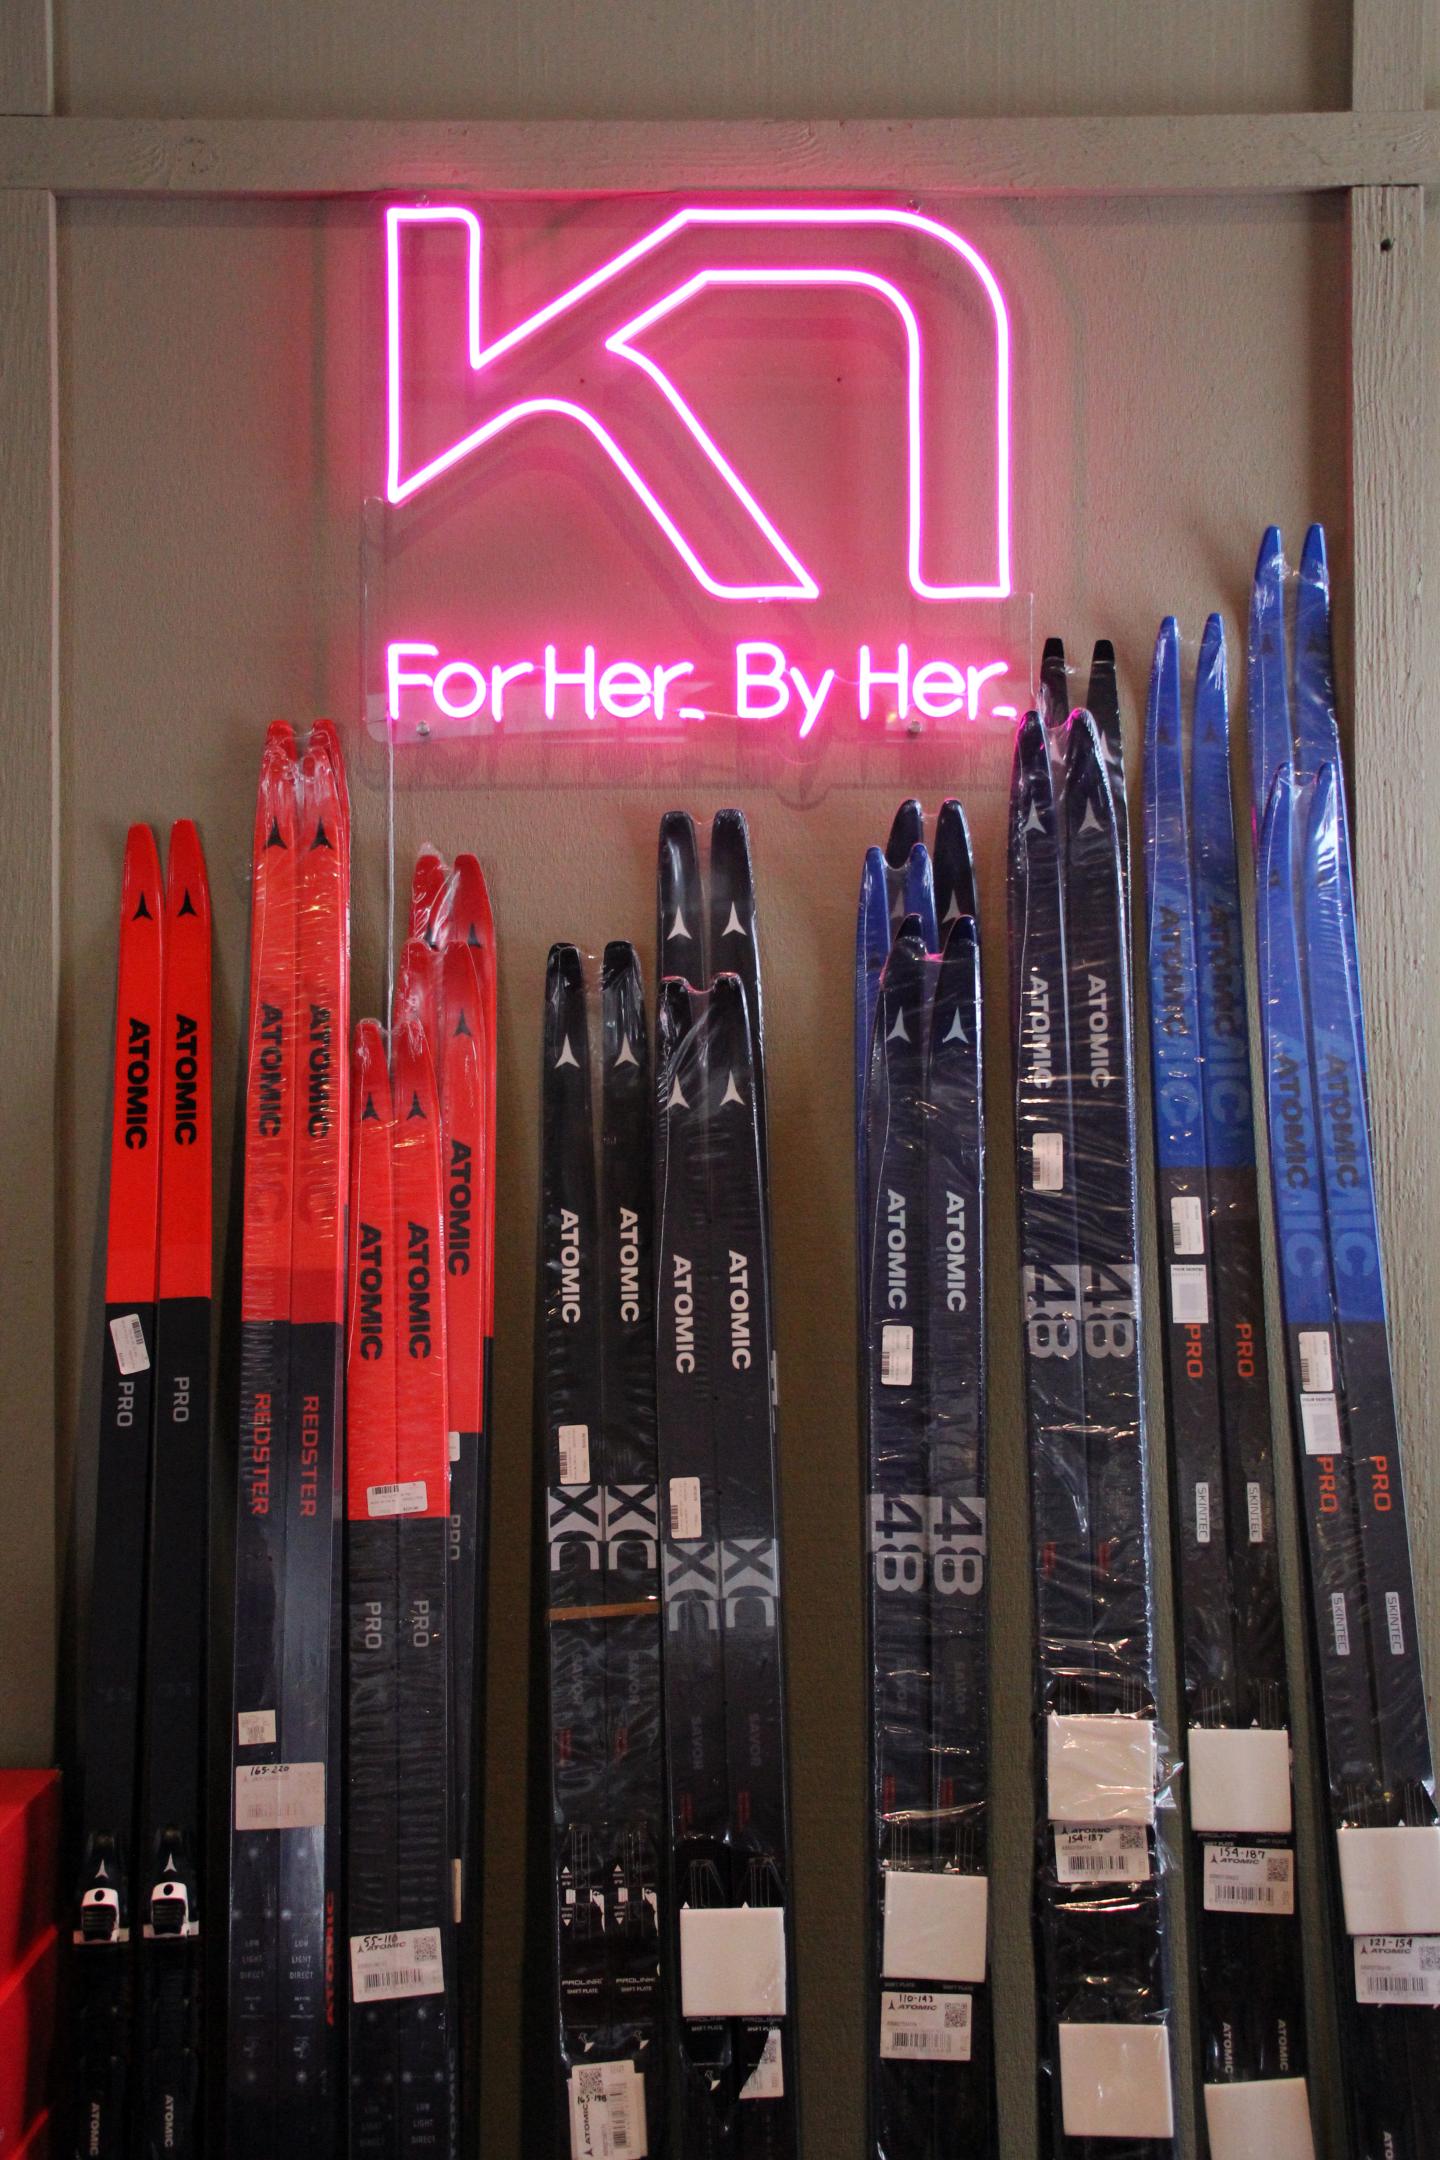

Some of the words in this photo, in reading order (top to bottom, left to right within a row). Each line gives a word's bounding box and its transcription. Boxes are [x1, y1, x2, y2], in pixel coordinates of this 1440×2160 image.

[387, 642, 535, 721] For
[736, 642, 836, 738] By
[259, 1003, 285, 1137] ATOMIC
[308, 1003, 332, 1139] ATOMIC
[1029, 974, 1052, 1090] ATOMIC
[1088, 973, 1110, 1089] ATOMIC
[125, 1018, 151, 1150] ATOMIC
[175, 1013, 198, 1146] ATOMIC
[1276, 1053, 1310, 1191] ATOMIC
[1325, 1052, 1360, 1190] ATOMIC
[448, 1139, 473, 1276] ATOMIC
[887, 1188, 907, 1311] ATOMIC
[945, 1190, 967, 1313] ATOMIC
[360, 1223, 383, 1361] ATOMIC
[407, 1220, 432, 1360] ATOMIC
[560, 1207, 581, 1324] ATOMIC
[619, 1206, 640, 1323] ATOMIC
[728, 1249, 752, 1371] ATOMIC
[1026, 1264, 1080, 1360] 48
[1082, 1264, 1136, 1360] 48
[673, 1253, 696, 1375] ATOMIC
[1185, 1323, 1204, 1379] PRO
[1235, 1322, 1255, 1378] PRO
[117, 1381, 135, 1428] PRO
[173, 1376, 190, 1423] PRO
[251, 1393, 272, 1515] REDSTER
[300, 1396, 319, 1517] REDSTER
[1316, 1456, 1341, 1515] PRO
[1369, 1455, 1393, 1513] PRO
[874, 1498, 925, 1593] 48
[933, 1498, 985, 1596] 48
[1198, 1487, 1209, 1538] SKINTEC
[1249, 1486, 1261, 1538] SKINTEC
[365, 1602, 382, 1649] PRO
[413, 1600, 429, 1648] PRO
[1333, 1596, 1348, 1650] SKINTEC
[1387, 1596, 1402, 1650] SKINTEC
[1219, 1847, 1266, 1859] 154-187
[289, 1971, 314, 1979] DIRECT
[1369, 1937, 1413, 1948] 121-154
[1222, 2022, 1233, 2074] ATOMIC
[1277, 2019, 1288, 2072] ATOMIC
[89, 2102, 100, 2157] ATOMIC
[163, 2094, 174, 2148] ATOMIC
[583, 2105, 591, 2145] ATOMIC
